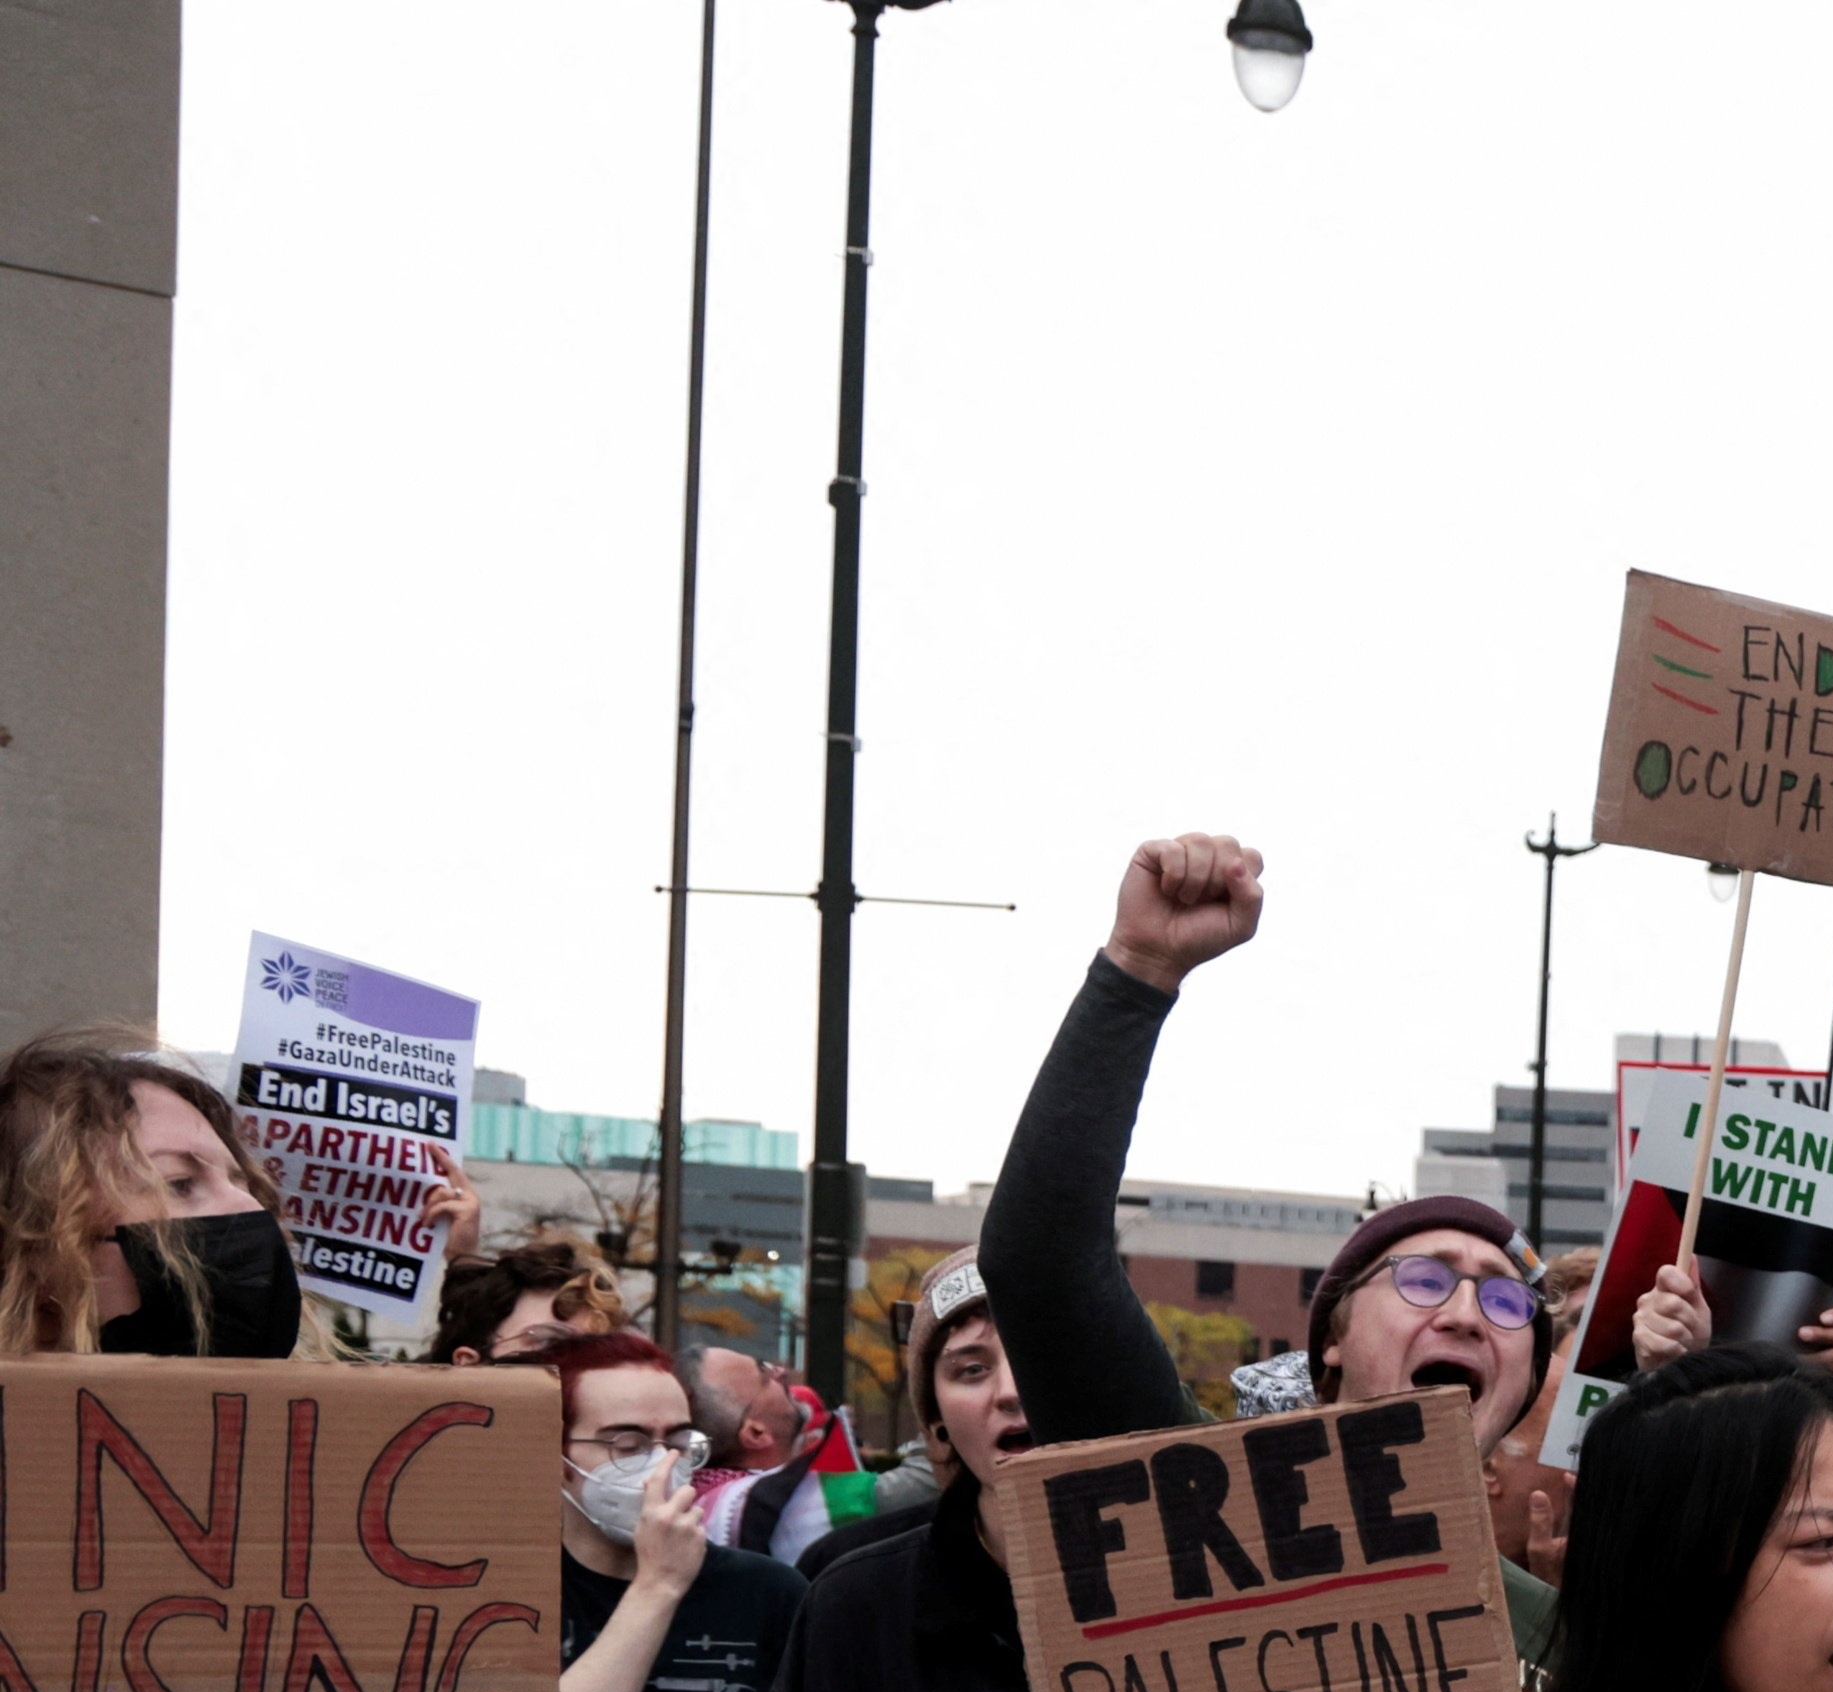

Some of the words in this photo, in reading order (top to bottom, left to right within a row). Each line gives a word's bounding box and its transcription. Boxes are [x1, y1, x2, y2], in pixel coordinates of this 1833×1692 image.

[315, 989, 348, 1004] PEACE
[278, 1039, 456, 1087] #GazaUnderAttack
[316, 1023, 456, 1066] #FreePalestine
[258, 1071, 328, 1113] End
[337, 1082, 450, 1134] Israel's
[1683, 1102, 1701, 1139] I
[263, 1156, 287, 1186] &
[1711, 1157, 1816, 1217] WITH
[301, 1237, 415, 1290] lestine
[0, 1386, 494, 1599] NIC
[1044, 1403, 1441, 1623] FREE
